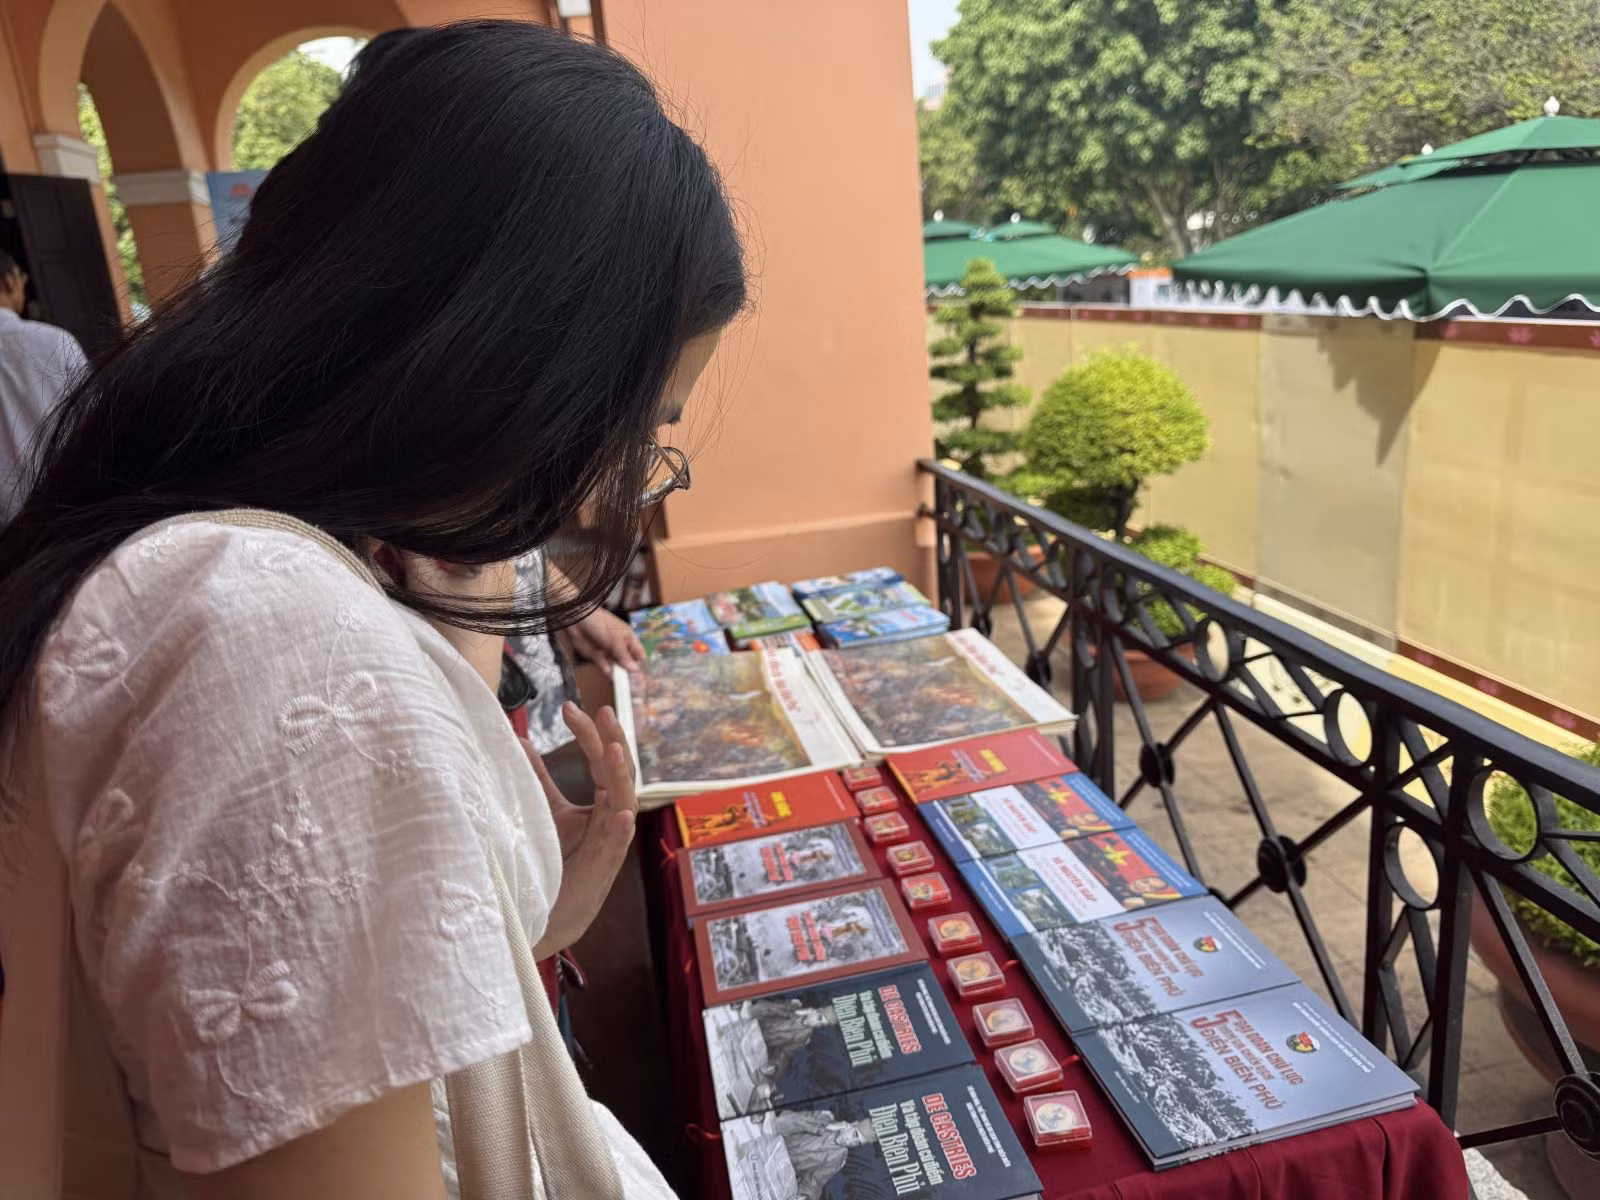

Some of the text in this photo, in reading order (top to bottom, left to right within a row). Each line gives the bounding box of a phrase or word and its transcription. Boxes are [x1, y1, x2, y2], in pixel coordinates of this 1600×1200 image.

[878, 984, 901, 1003] DE
[1191, 1009, 1242, 1028] 5
[1224, 1055, 1257, 1083] BIÊN
[1248, 1083, 1286, 1110] PHỦ
[879, 1132, 909, 1167] Biên
[922, 1092, 977, 1180] DE CASTRIES
[889, 1161, 926, 1196] Phủ
